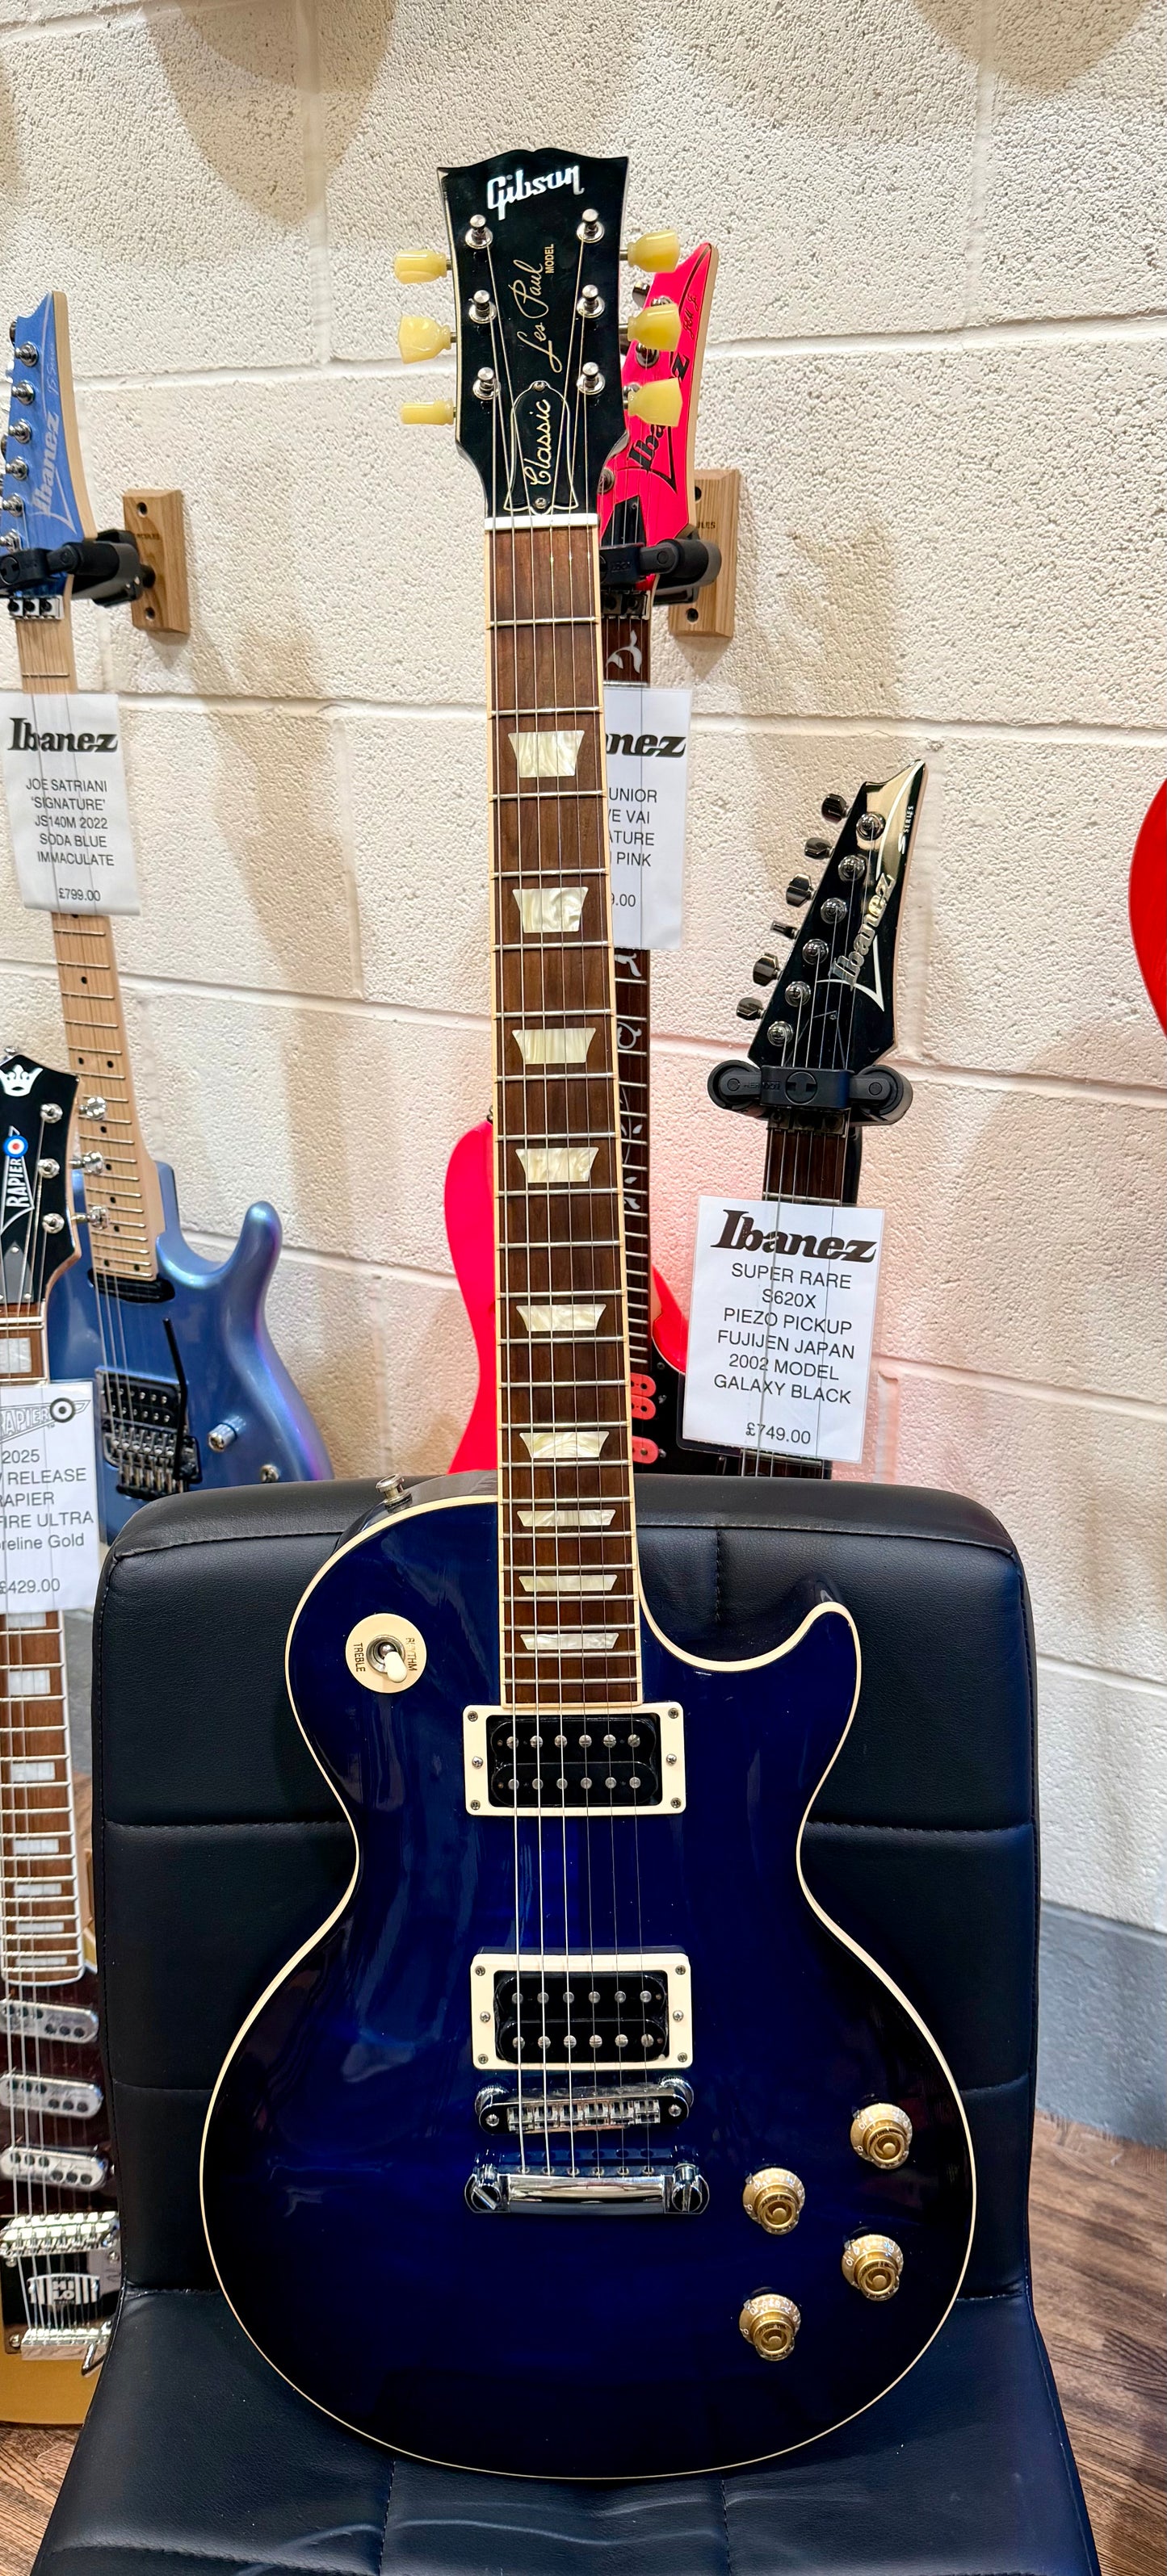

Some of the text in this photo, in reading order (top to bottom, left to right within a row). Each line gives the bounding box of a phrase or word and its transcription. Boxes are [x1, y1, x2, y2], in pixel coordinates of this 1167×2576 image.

[487, 165, 585, 220] Gibson
[544, 244, 555, 274] MODEL
[508, 259, 563, 373] Les Paul
[627, 352, 691, 475] Ibaz
[523, 399, 552, 485] Classic
[32, 411, 60, 517] Ibanez
[7, 718, 119, 752] Ibanez
[607, 734, 686, 757] nez
[26, 778, 107, 792] JOE SATRIANI
[35, 815, 108, 829] JS140M 2022
[608, 809, 650, 824] E VAI
[904, 806, 913, 833] SERIES
[40, 833, 107, 848] SODA BLUE
[610, 831, 655, 846] TURE
[37, 851, 115, 866] IMMACULATE
[616, 852, 651, 867] PINK
[58, 888, 101, 902] £799.00
[828, 872, 896, 992] Ibanez
[6, 1158, 30, 1207] RAPIER
[710, 1209, 878, 1263] Ibanez
[732, 1263, 852, 1289] SUPER RARE
[762, 1289, 816, 1309] S620X
[724, 1308, 853, 1334] PIEZO PICKUP
[717, 1330, 854, 1359] FUJIJEN JAPAN
[728, 1354, 839, 1380] 2002 MODEL
[714, 1375, 851, 1404] GALAXY BLACK
[745, 1422, 811, 1444] £749.00
[2, 1449, 40, 1464] 2025
[7, 1468, 86, 1485] RELEASE
[0, 1510, 94, 1528] IRE ULTRA
[0, 1532, 84, 1550] reline Gold
[0, 1578, 61, 1594] £429.00
[354, 1642, 366, 1672] TREBLE
